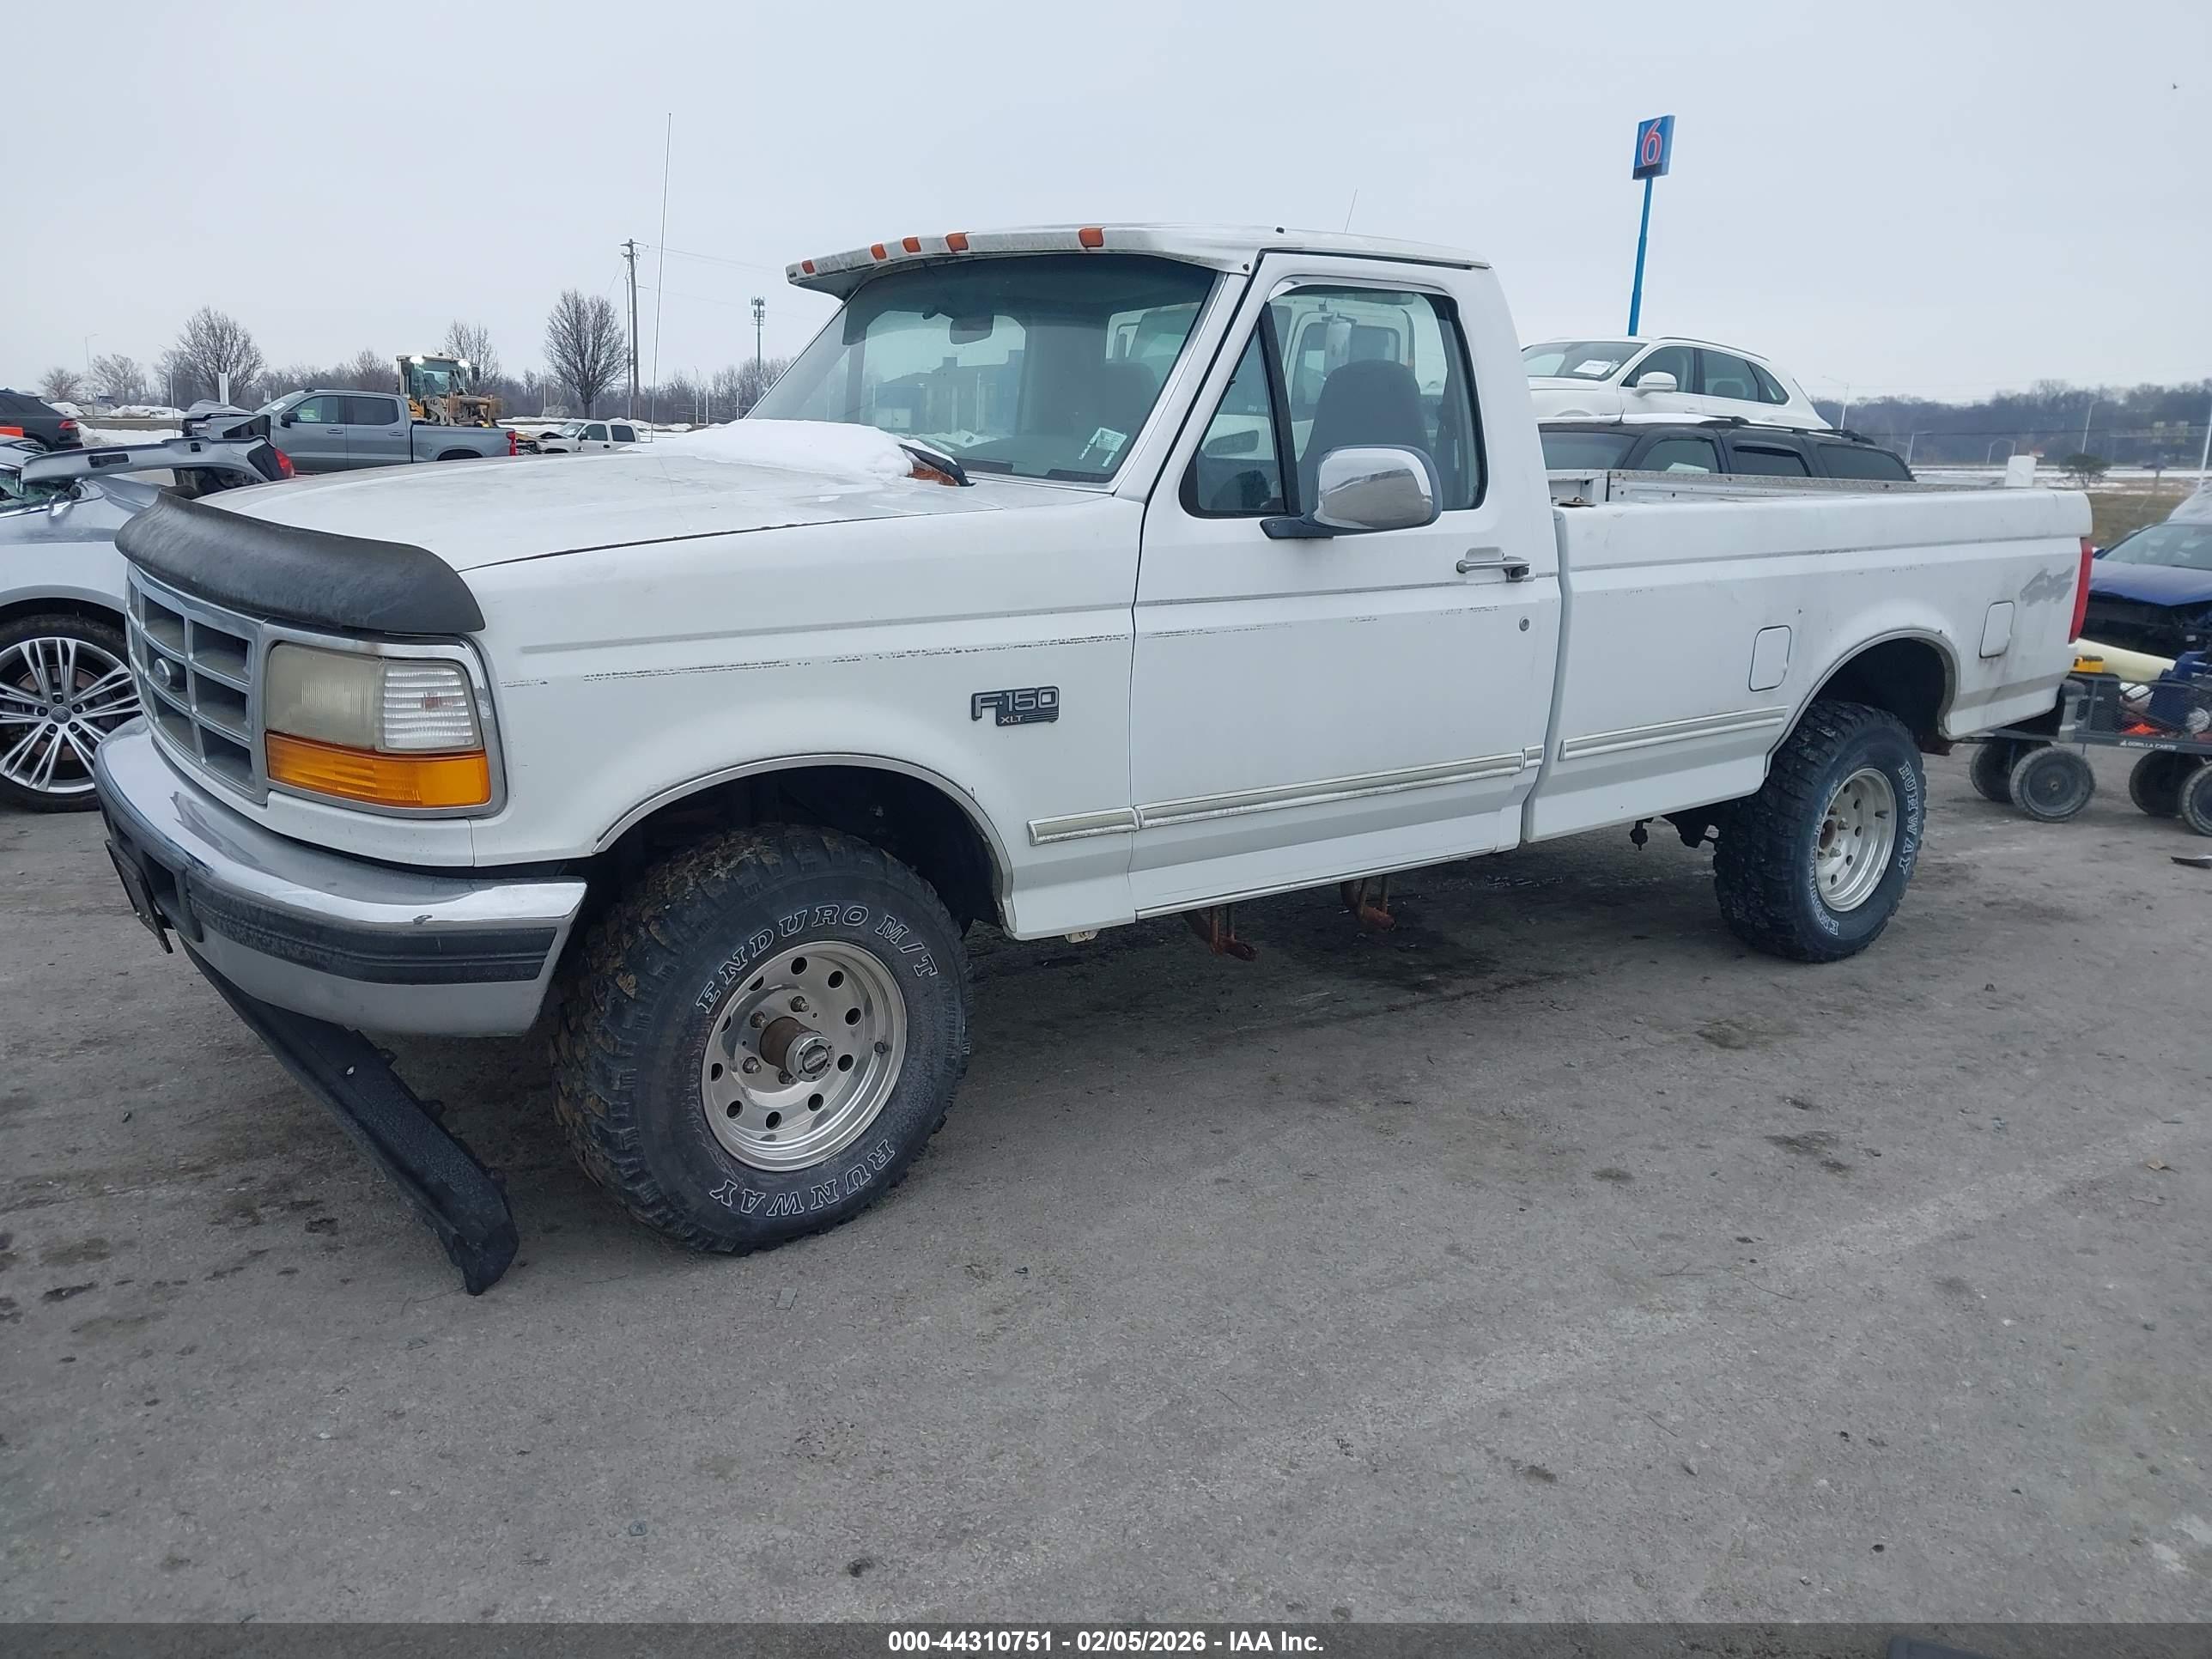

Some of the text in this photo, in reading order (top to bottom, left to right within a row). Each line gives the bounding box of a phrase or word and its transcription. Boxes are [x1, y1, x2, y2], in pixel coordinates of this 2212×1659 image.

[1641, 118, 1662, 165] 6
[1000, 714, 1024, 723] XLT
[1899, 761, 1919, 875] RUNWAY
[696, 905, 939, 1014] ENDURO M/T
[709, 1139, 896, 1217] RUNWAY
